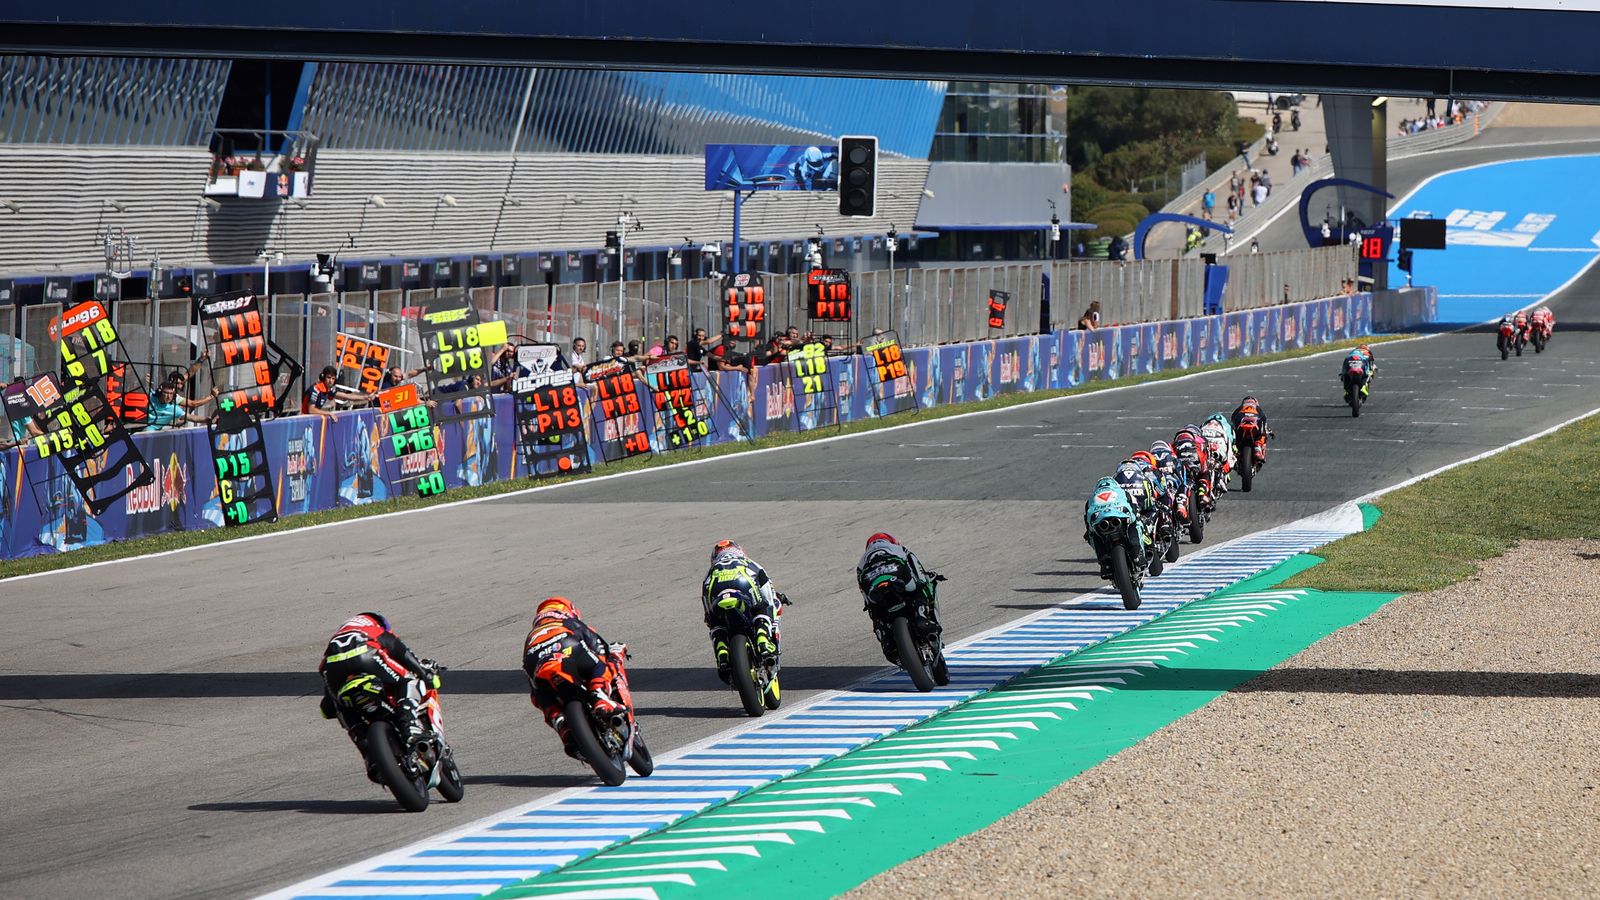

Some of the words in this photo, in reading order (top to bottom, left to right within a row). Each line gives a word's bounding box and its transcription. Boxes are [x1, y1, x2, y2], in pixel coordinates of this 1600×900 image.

[1363, 237, 1382, 258] 18
[218, 311, 262, 340] L18
[222, 335, 264, 366] P17
[437, 327, 479, 351] L18
[440, 350, 483, 373] P18
[796, 356, 826, 377] L18
[874, 345, 900, 366] L18
[877, 360, 905, 382] P19
[26, 375, 58, 407] 16
[598, 373, 634, 400] L18
[533, 387, 576, 412] L18
[602, 393, 640, 419] P13
[389, 406, 430, 434] L18
[538, 407, 580, 434] P13
[391, 428, 434, 457] P16
[625, 431, 650, 454] +0
[216, 451, 251, 480] P15
[417, 472, 446, 495] +0
[227, 501, 248, 524] +0
